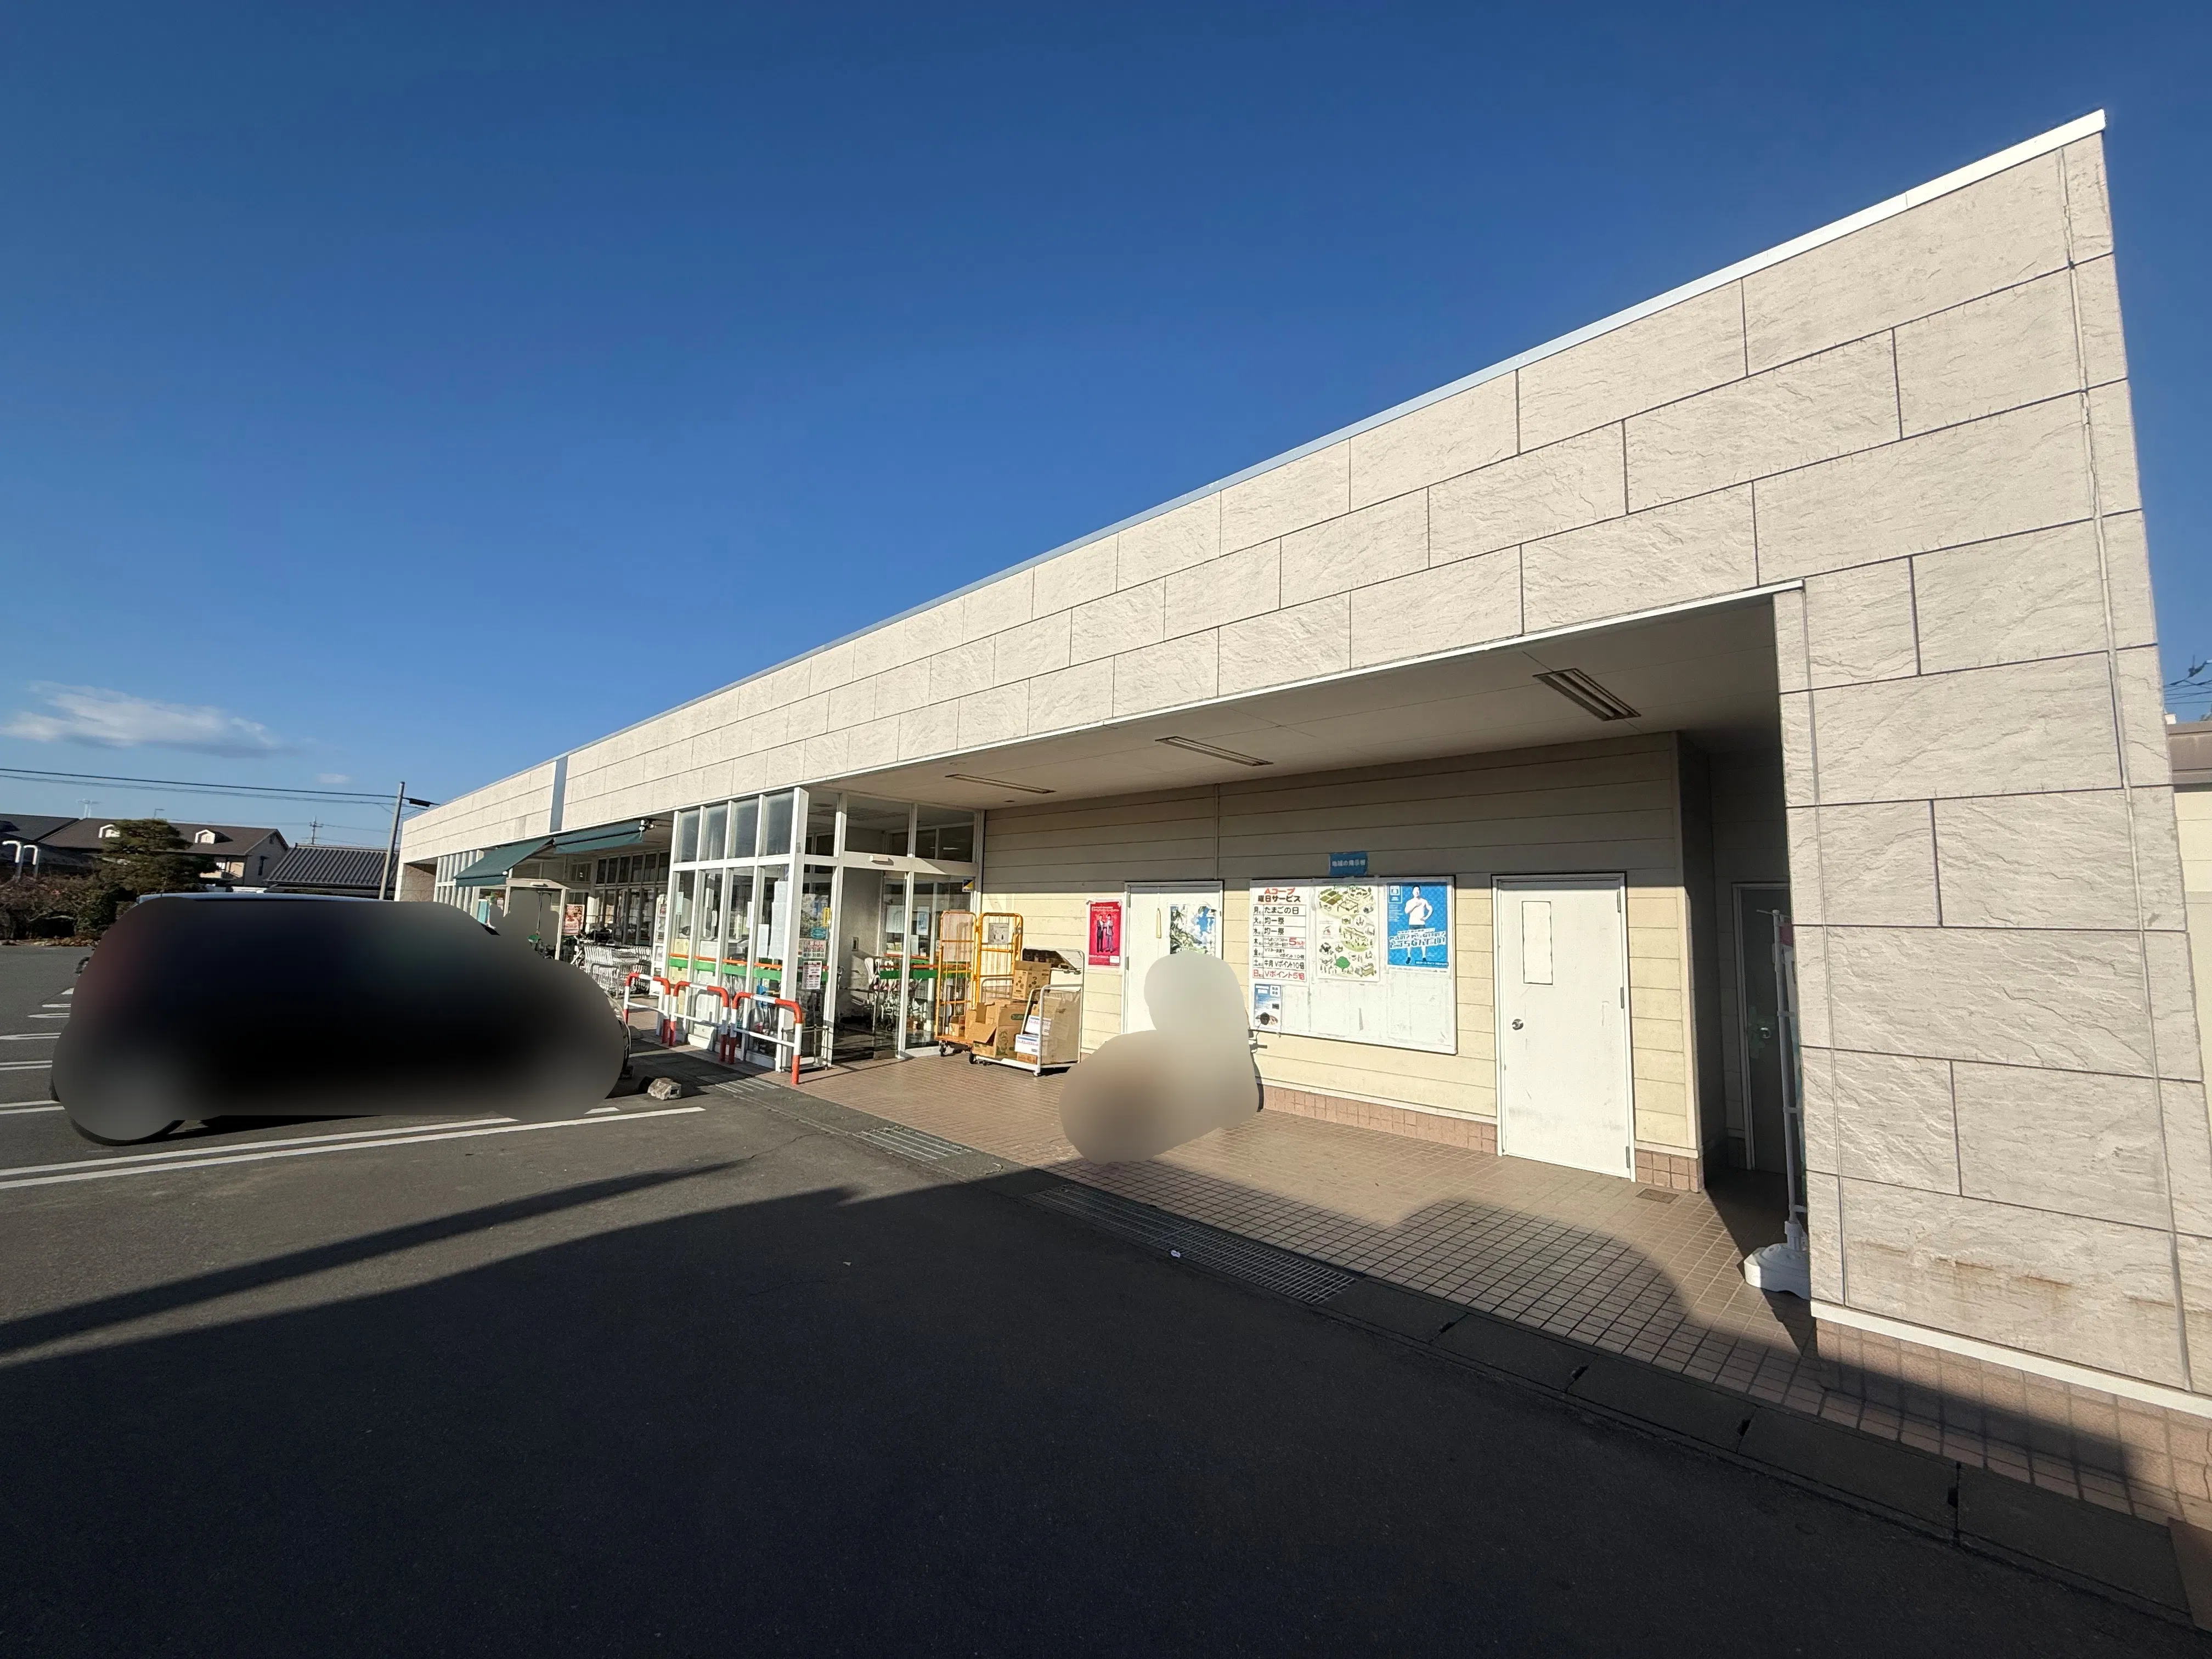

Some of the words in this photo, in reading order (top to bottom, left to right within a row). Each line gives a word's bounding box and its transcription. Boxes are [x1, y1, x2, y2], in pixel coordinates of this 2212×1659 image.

[1264, 906, 1299, 915] たまごの日
[1264, 927, 1284, 935] 均一祭
